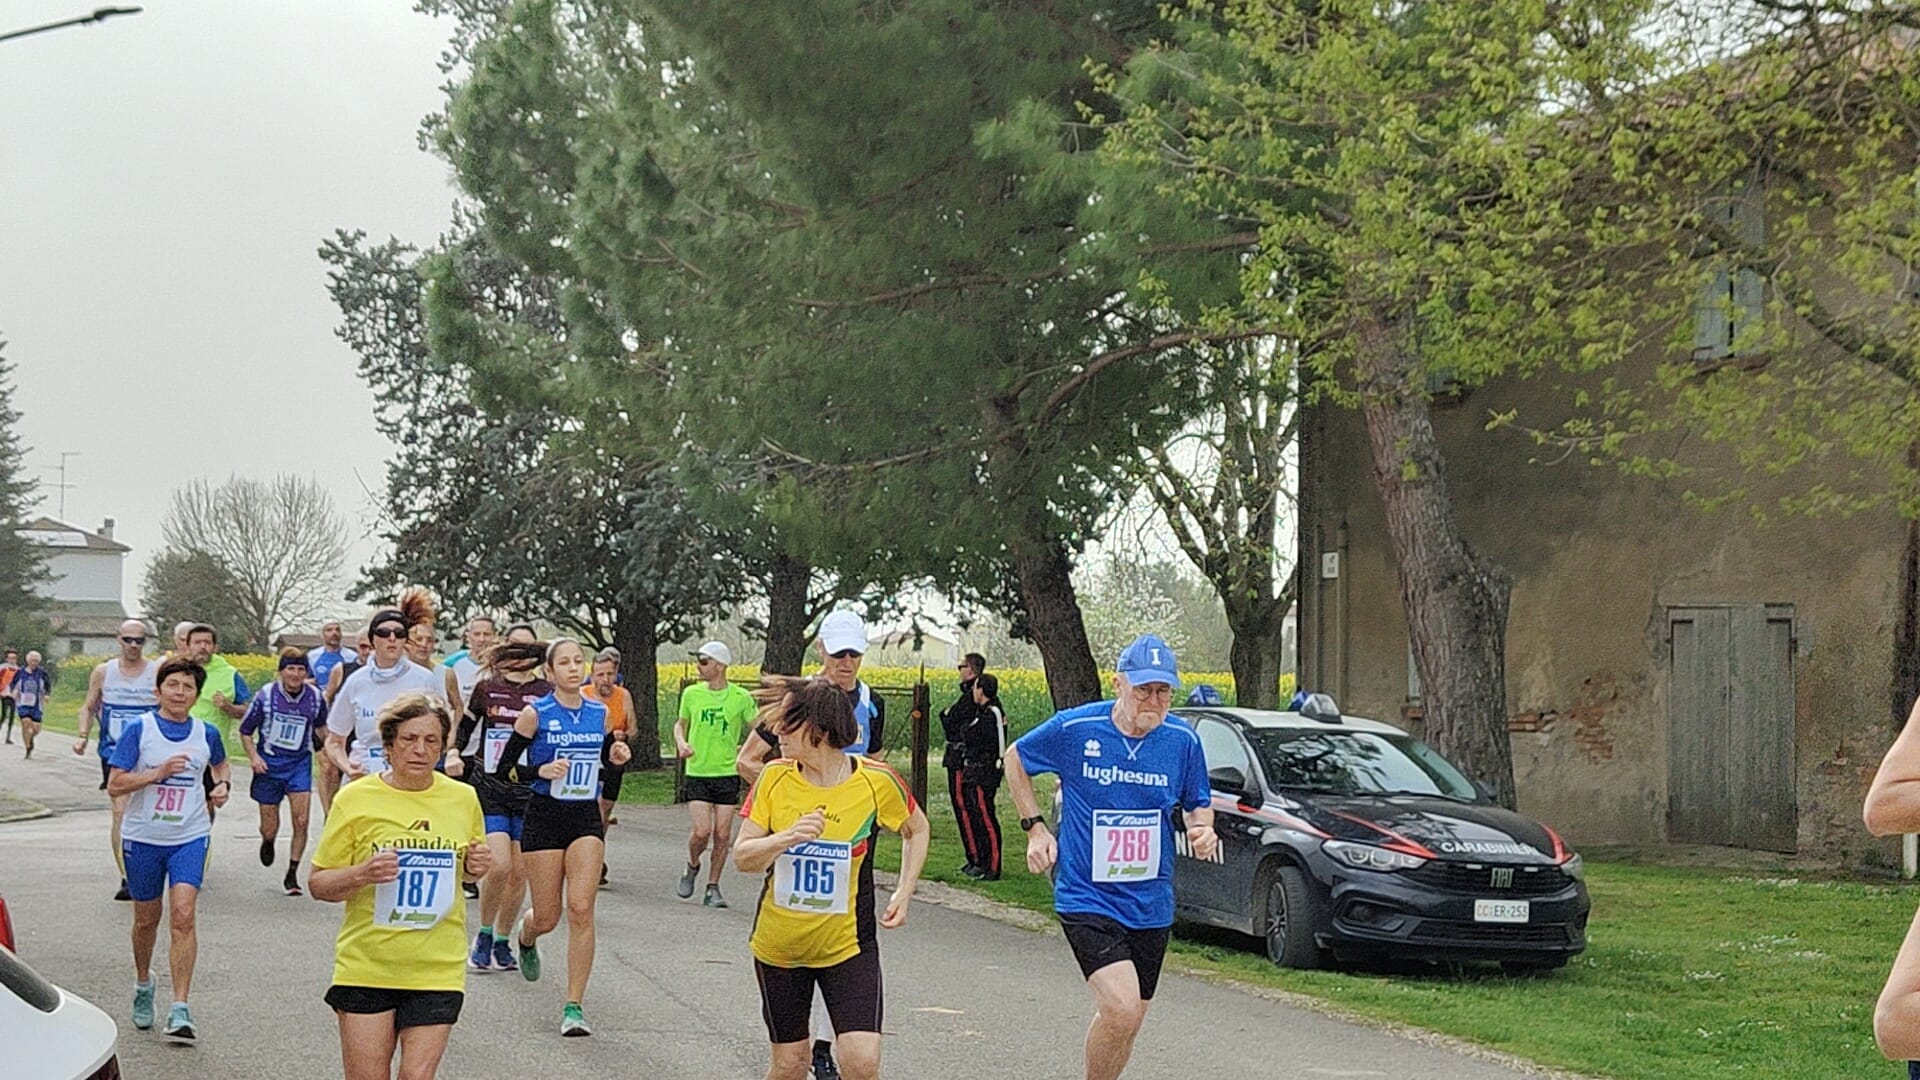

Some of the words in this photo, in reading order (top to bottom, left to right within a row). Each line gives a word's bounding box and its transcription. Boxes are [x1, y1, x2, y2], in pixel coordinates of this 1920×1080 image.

[566, 762, 593, 786] 107
[1083, 761, 1168, 786] lughesina
[154, 786, 186, 812] 267
[1107, 829, 1150, 862] 268
[1440, 841, 1541, 857] CARABINIERI
[397, 870, 439, 908] 187
[792, 858, 836, 895] 165
[1490, 868, 1514, 888] FIAT
